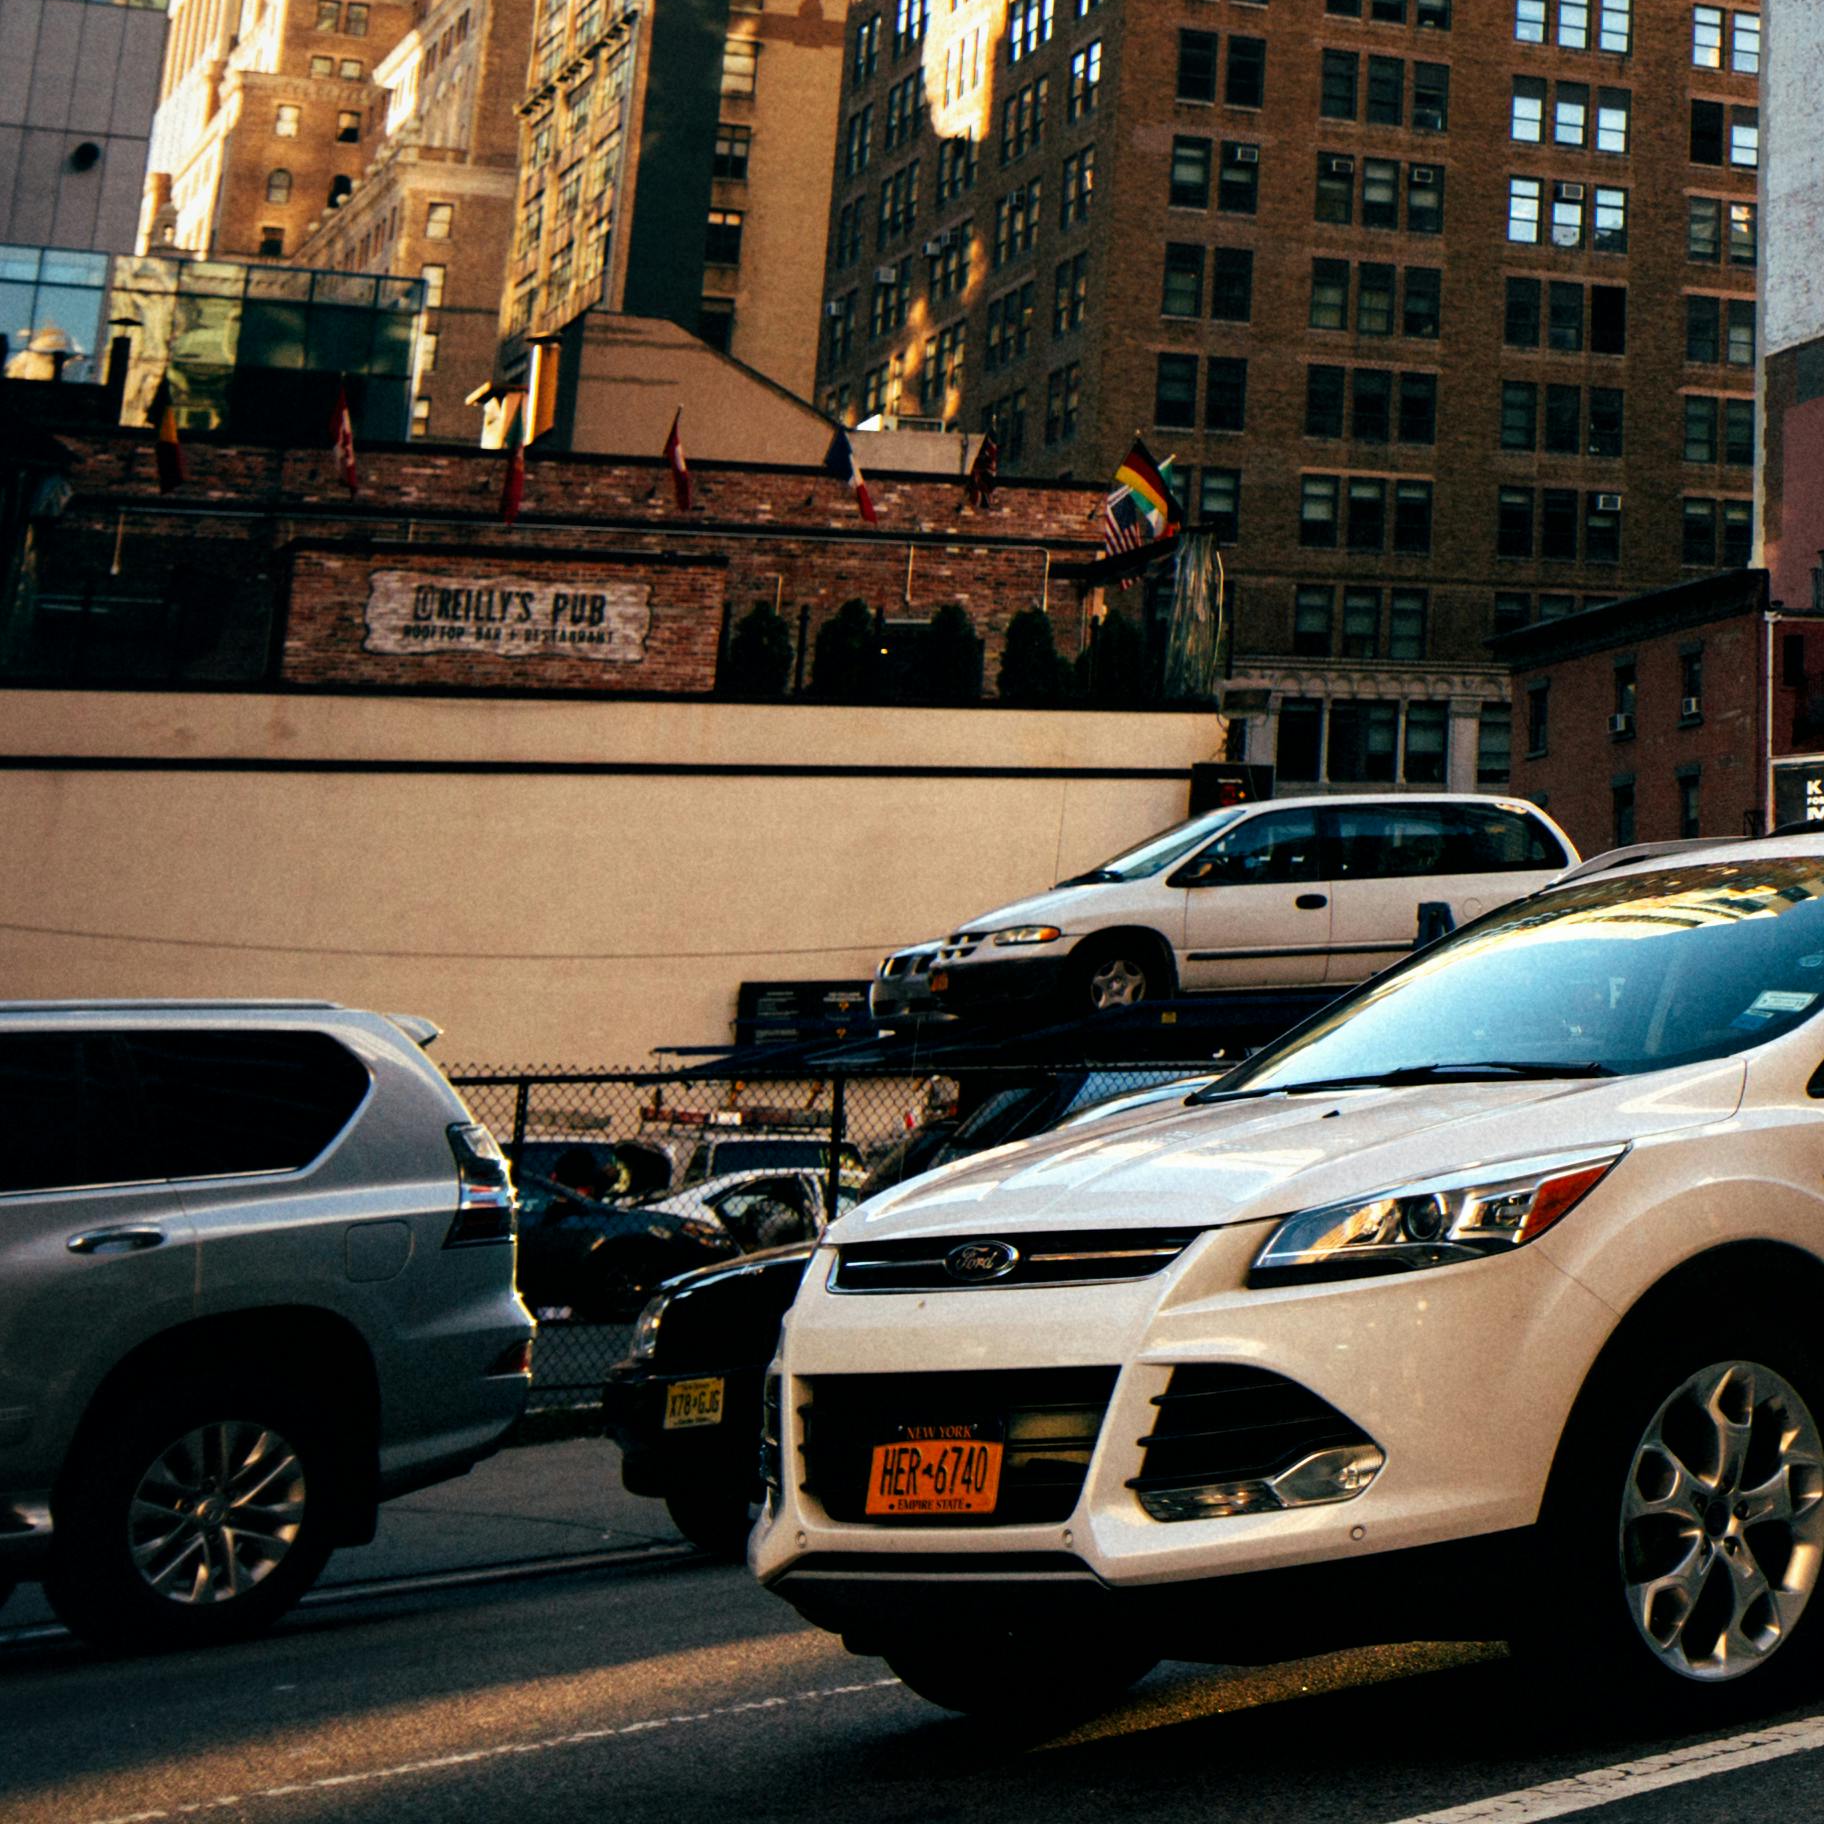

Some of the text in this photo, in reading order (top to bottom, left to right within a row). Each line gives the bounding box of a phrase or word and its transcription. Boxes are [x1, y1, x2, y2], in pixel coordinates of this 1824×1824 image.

[552, 592, 606, 626] PUB
[403, 624, 465, 642] ROOFTOP
[475, 627, 501, 642] BAR
[524, 628, 614, 644] RESTAURANT
[956, 1247, 998, 1270] Ford
[907, 1425, 972, 1440] NEW YORK
[897, 1498, 964, 1510] EMPIRE STATE
